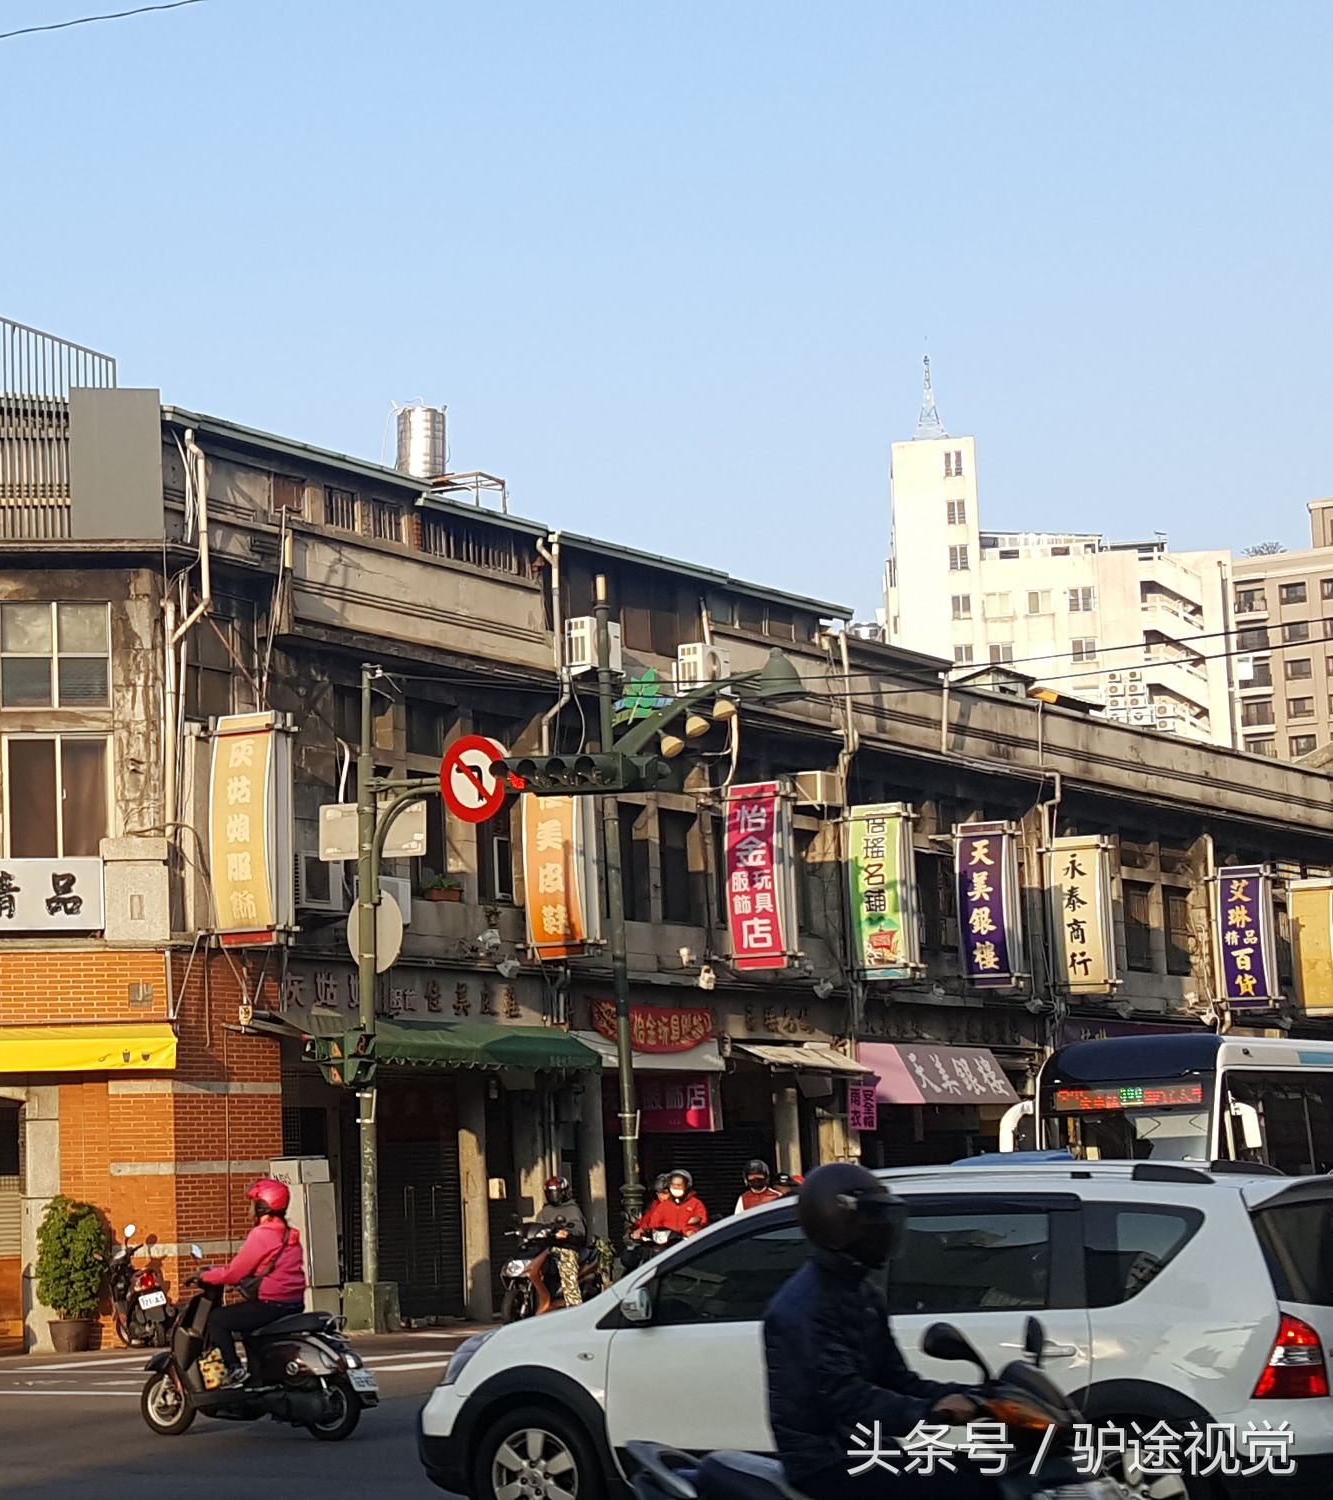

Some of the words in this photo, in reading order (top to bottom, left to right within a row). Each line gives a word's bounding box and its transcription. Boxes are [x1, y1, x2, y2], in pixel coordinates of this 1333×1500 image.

[967, 839, 999, 971] 天美銀樓
[1062, 853, 1092, 976] 永泰商行
